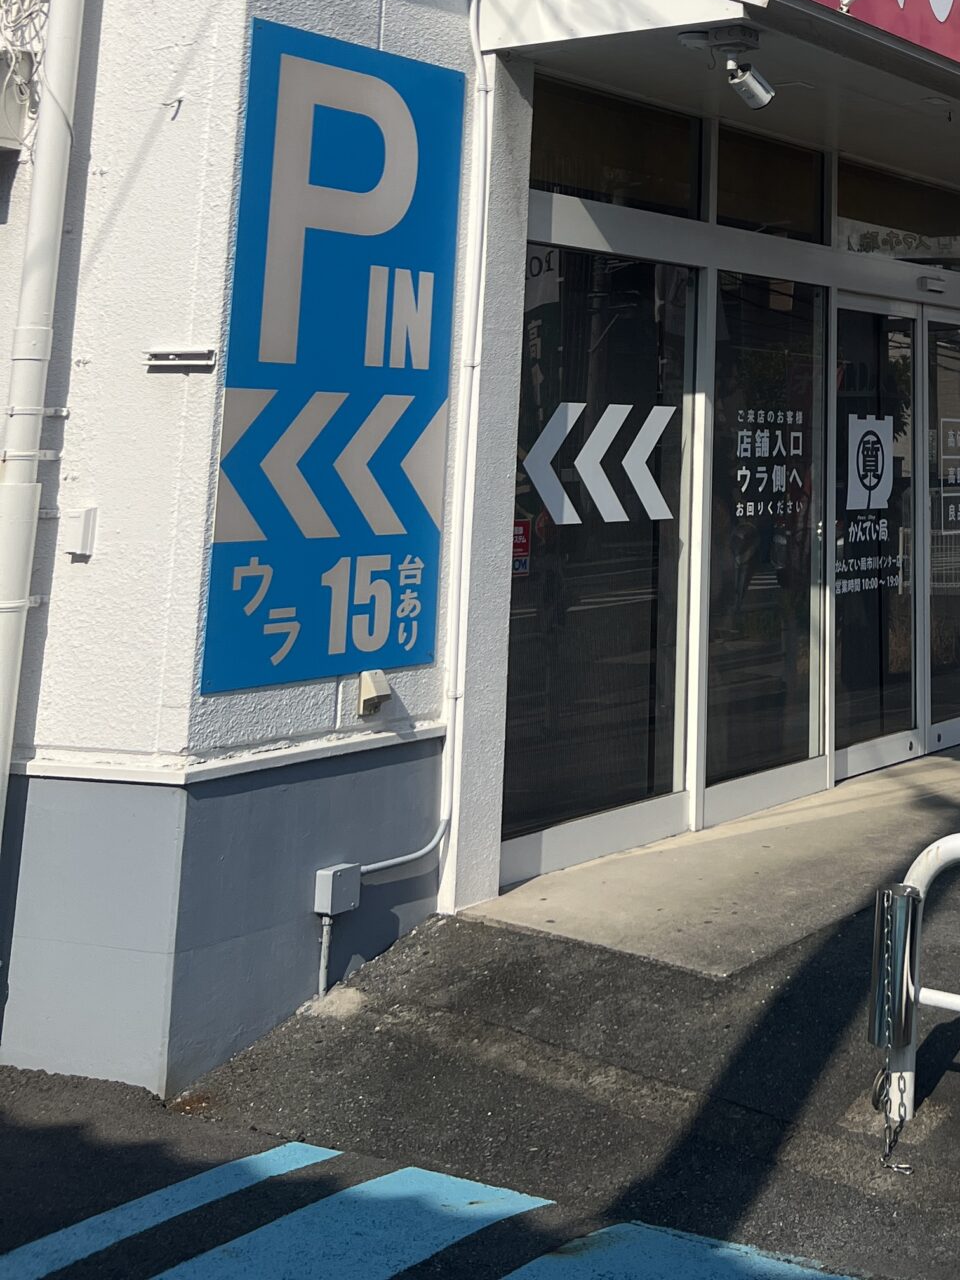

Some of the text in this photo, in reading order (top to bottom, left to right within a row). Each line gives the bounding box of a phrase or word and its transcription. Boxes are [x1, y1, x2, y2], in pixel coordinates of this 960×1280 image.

[257, 53, 419, 365] P
[364, 264, 435, 370] IN
[737, 429, 802, 458] 店舗入口
[737, 465, 803, 493] ウラ側へ
[736, 500, 803, 516] お回りください
[848, 519, 889, 542] かんてい局
[862, 576, 878, 590] 10:00
[231, 554, 423, 666] ウラ 15 台あり
